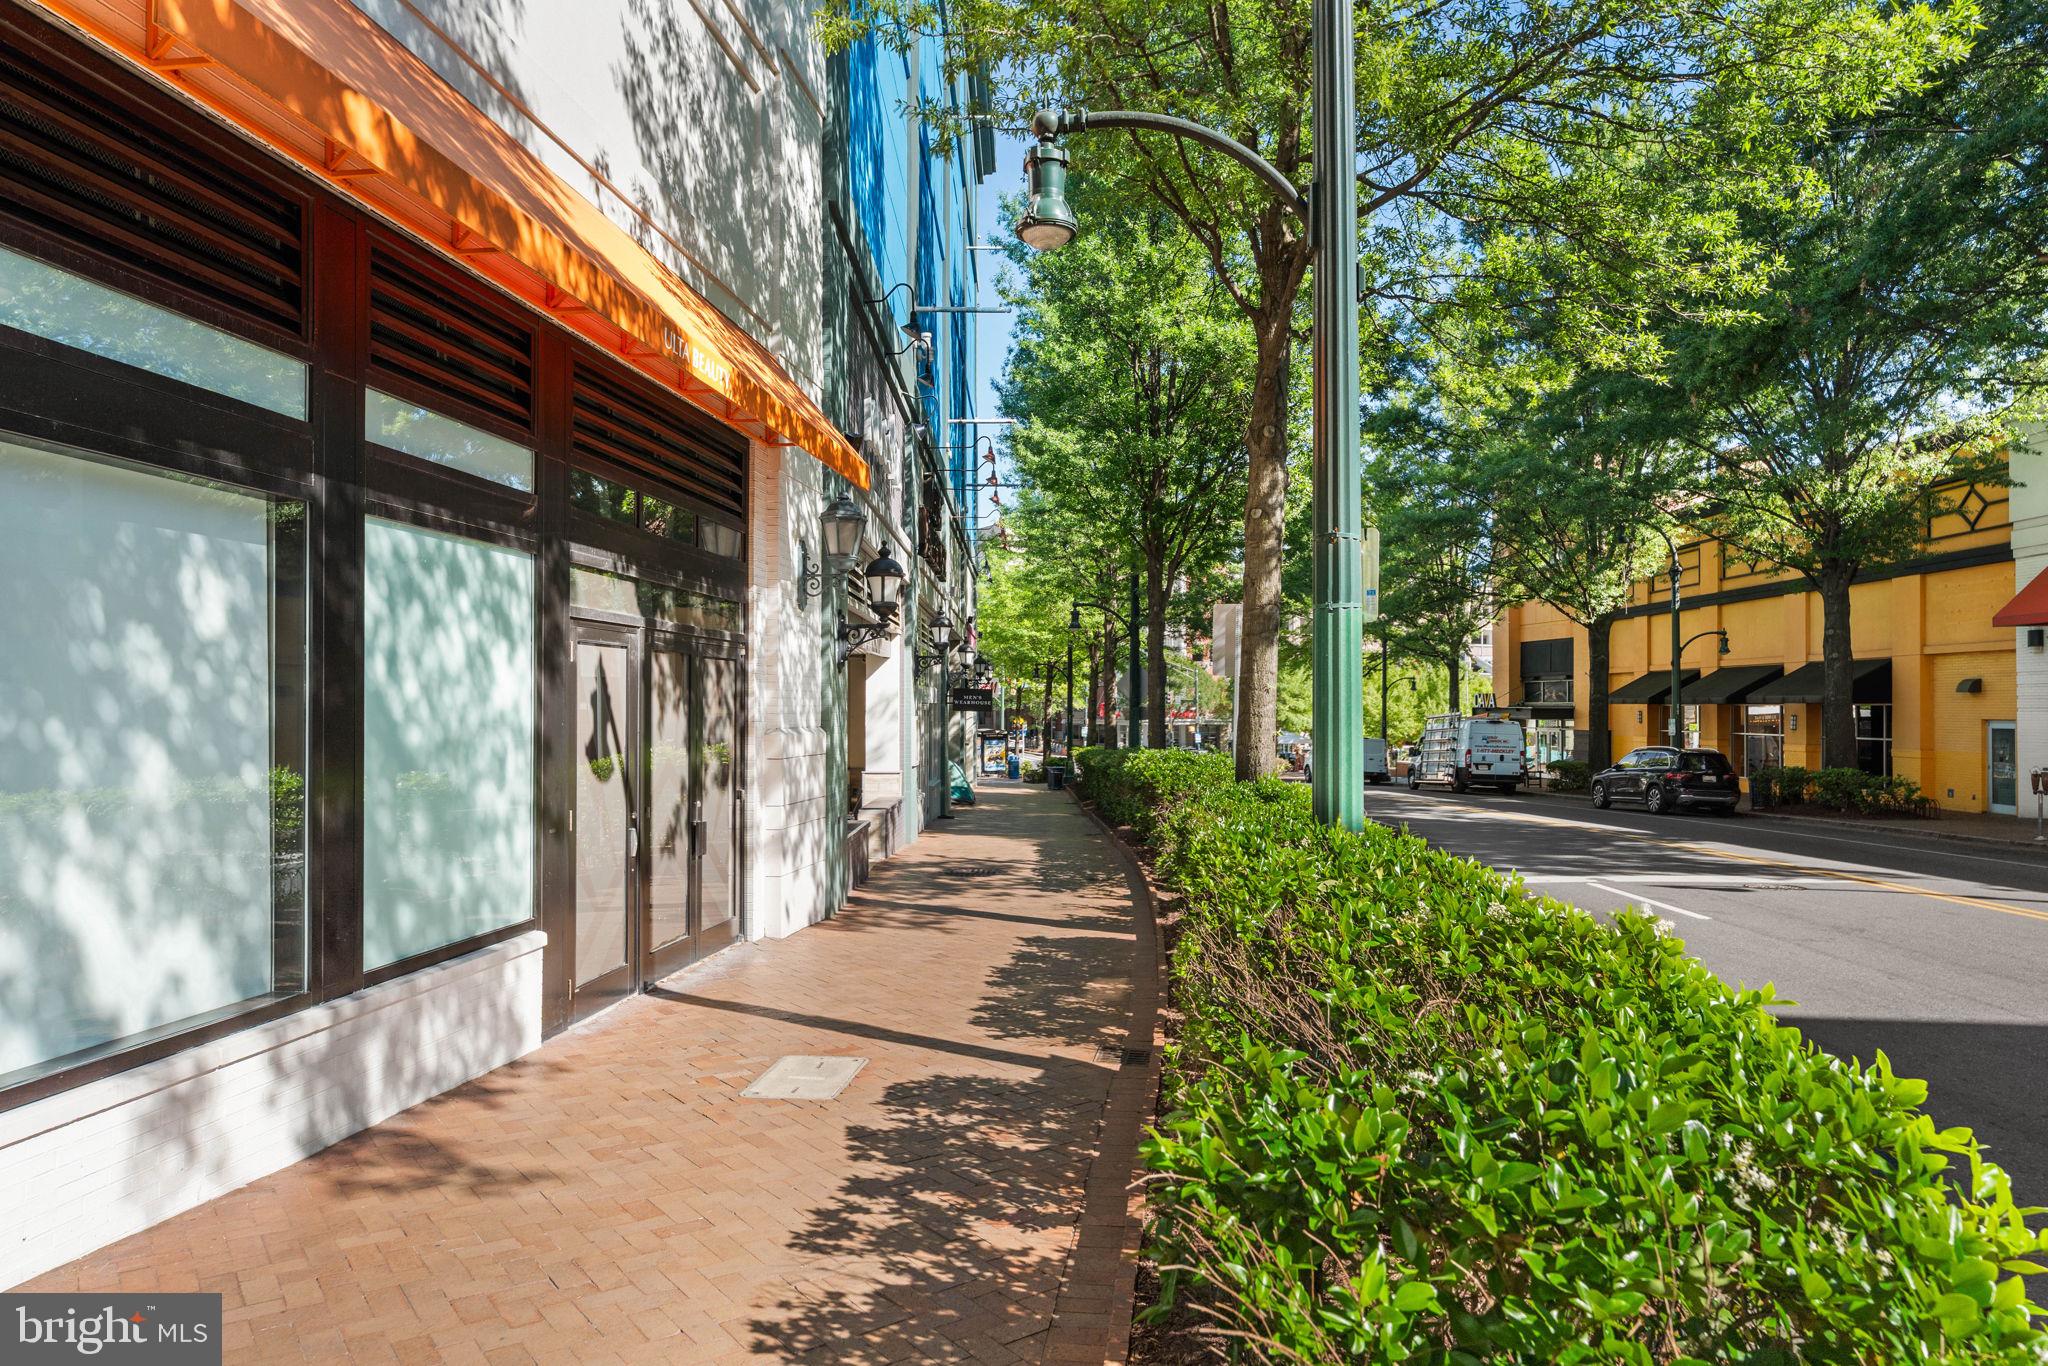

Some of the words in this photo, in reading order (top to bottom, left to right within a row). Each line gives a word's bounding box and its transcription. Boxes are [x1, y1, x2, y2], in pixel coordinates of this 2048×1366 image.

[664, 327, 690, 363] ULTA
[692, 347, 730, 390] BEAUTY
[1474, 693, 1496, 708] CAVA
